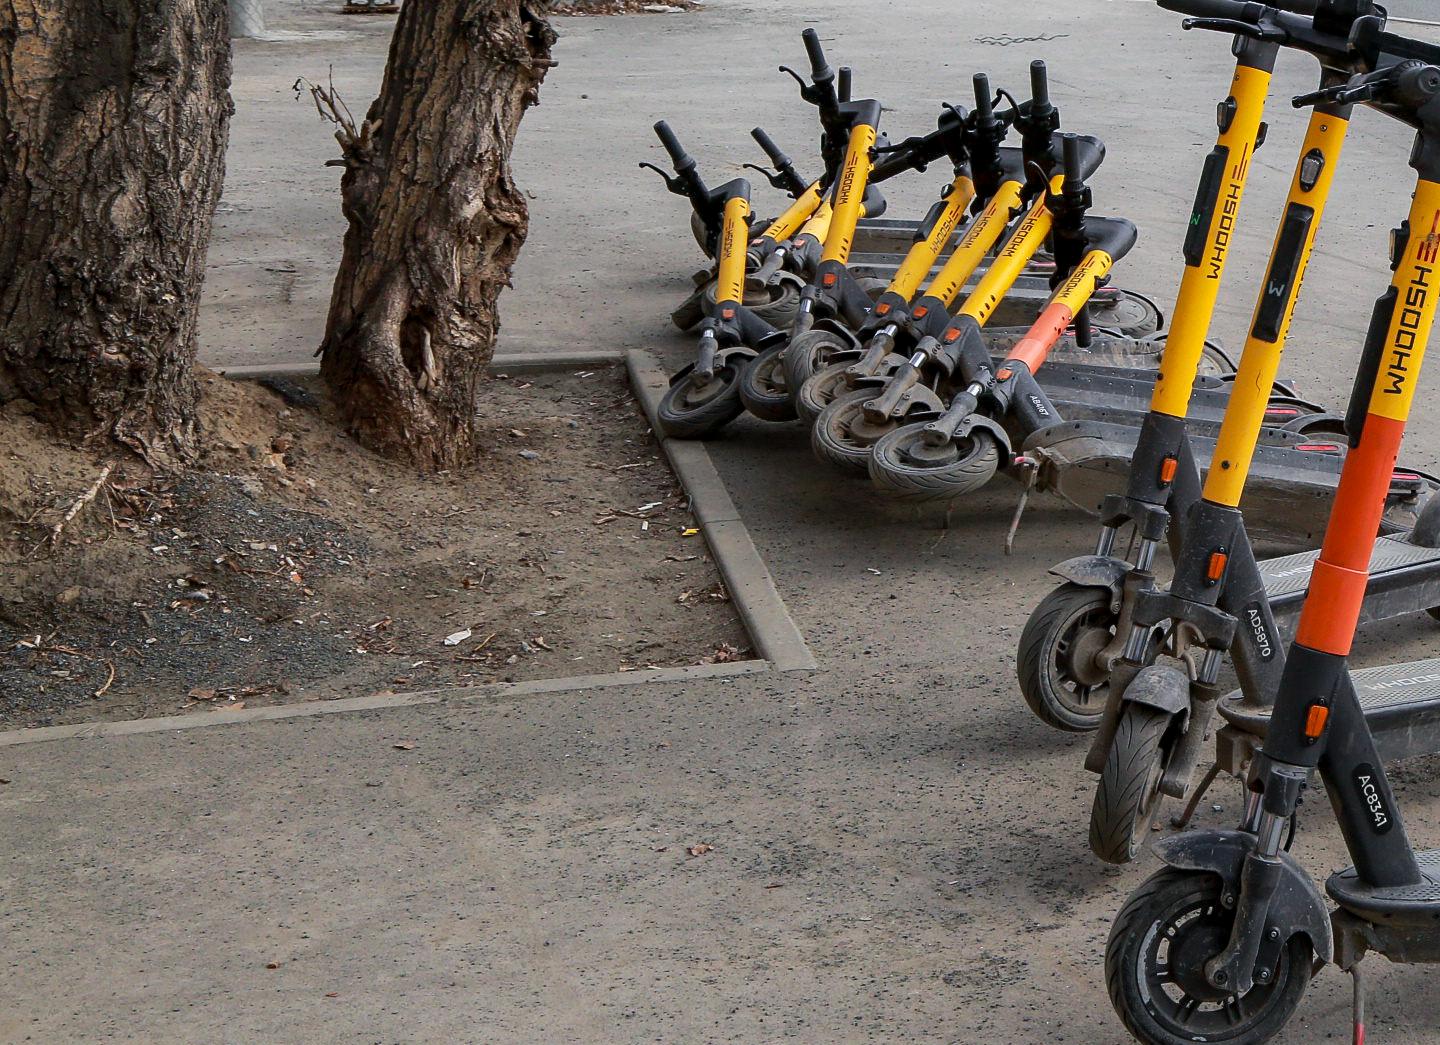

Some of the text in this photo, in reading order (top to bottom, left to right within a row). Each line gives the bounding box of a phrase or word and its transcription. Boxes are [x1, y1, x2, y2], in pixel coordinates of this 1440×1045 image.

[838, 163, 856, 206] WHOOSH
[929, 217, 955, 254] WHOOSH
[961, 215, 991, 250] WHOOSH
[1002, 216, 1038, 258] WHOOSH
[1207, 183, 1241, 280] WHOOSH
[1058, 265, 1088, 299] WHOOSH
[1383, 264, 1433, 395] WHOOSH
[1247, 608, 1271, 658] AD5870
[1357, 774, 1388, 828] AC8341
